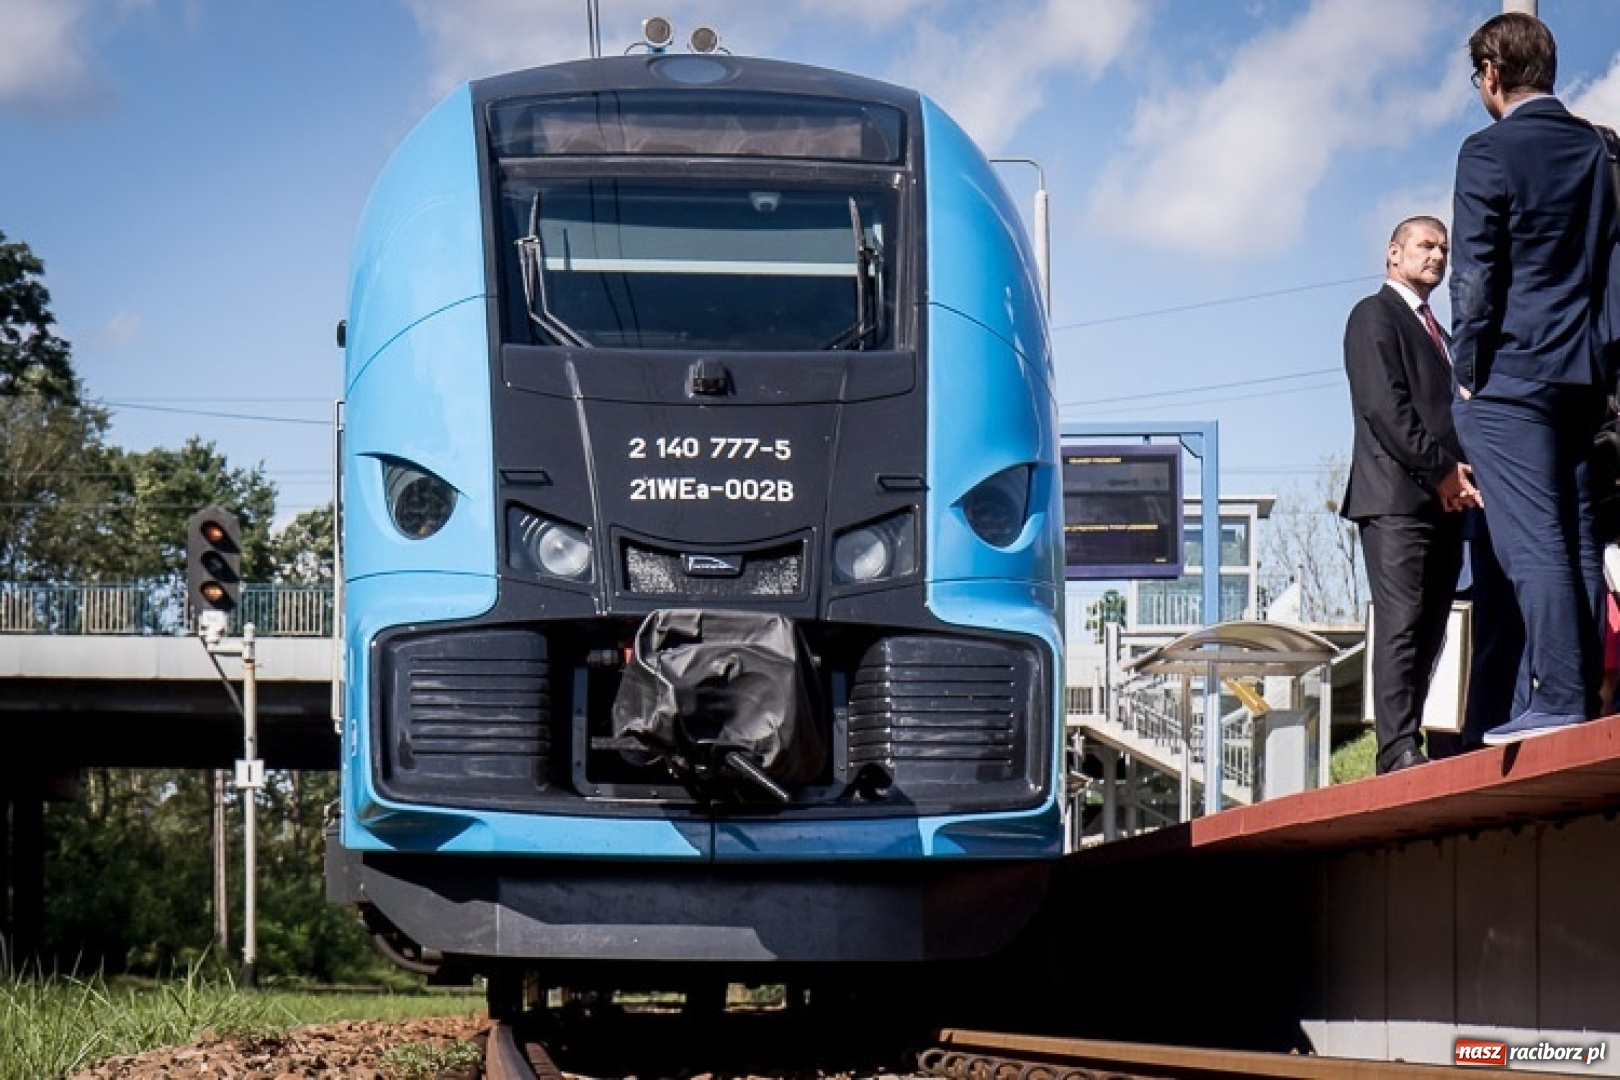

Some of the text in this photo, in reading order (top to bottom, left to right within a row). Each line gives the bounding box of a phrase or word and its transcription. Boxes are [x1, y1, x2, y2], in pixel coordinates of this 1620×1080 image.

[628, 437, 792, 460] 2 140 777-5
[629, 477, 794, 501] 21WEa-002B
